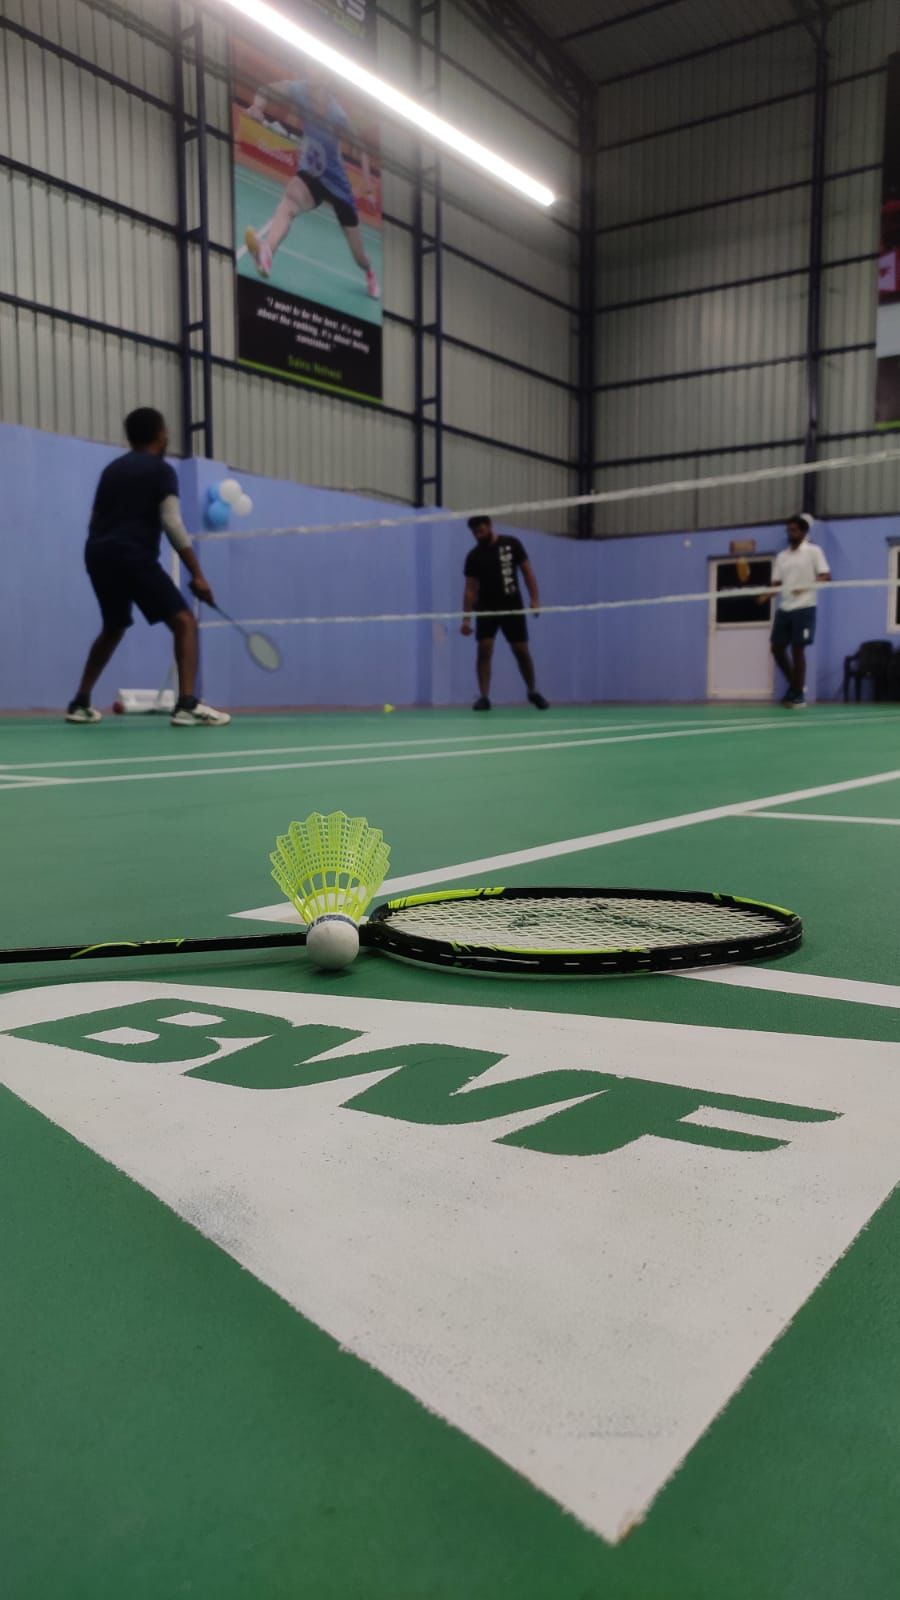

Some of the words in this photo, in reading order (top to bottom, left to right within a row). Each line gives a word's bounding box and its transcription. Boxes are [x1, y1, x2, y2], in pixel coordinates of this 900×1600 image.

[280, 313, 291, 327] the
[312, 312, 323, 325] the
[1, 998, 844, 1156] BWF
